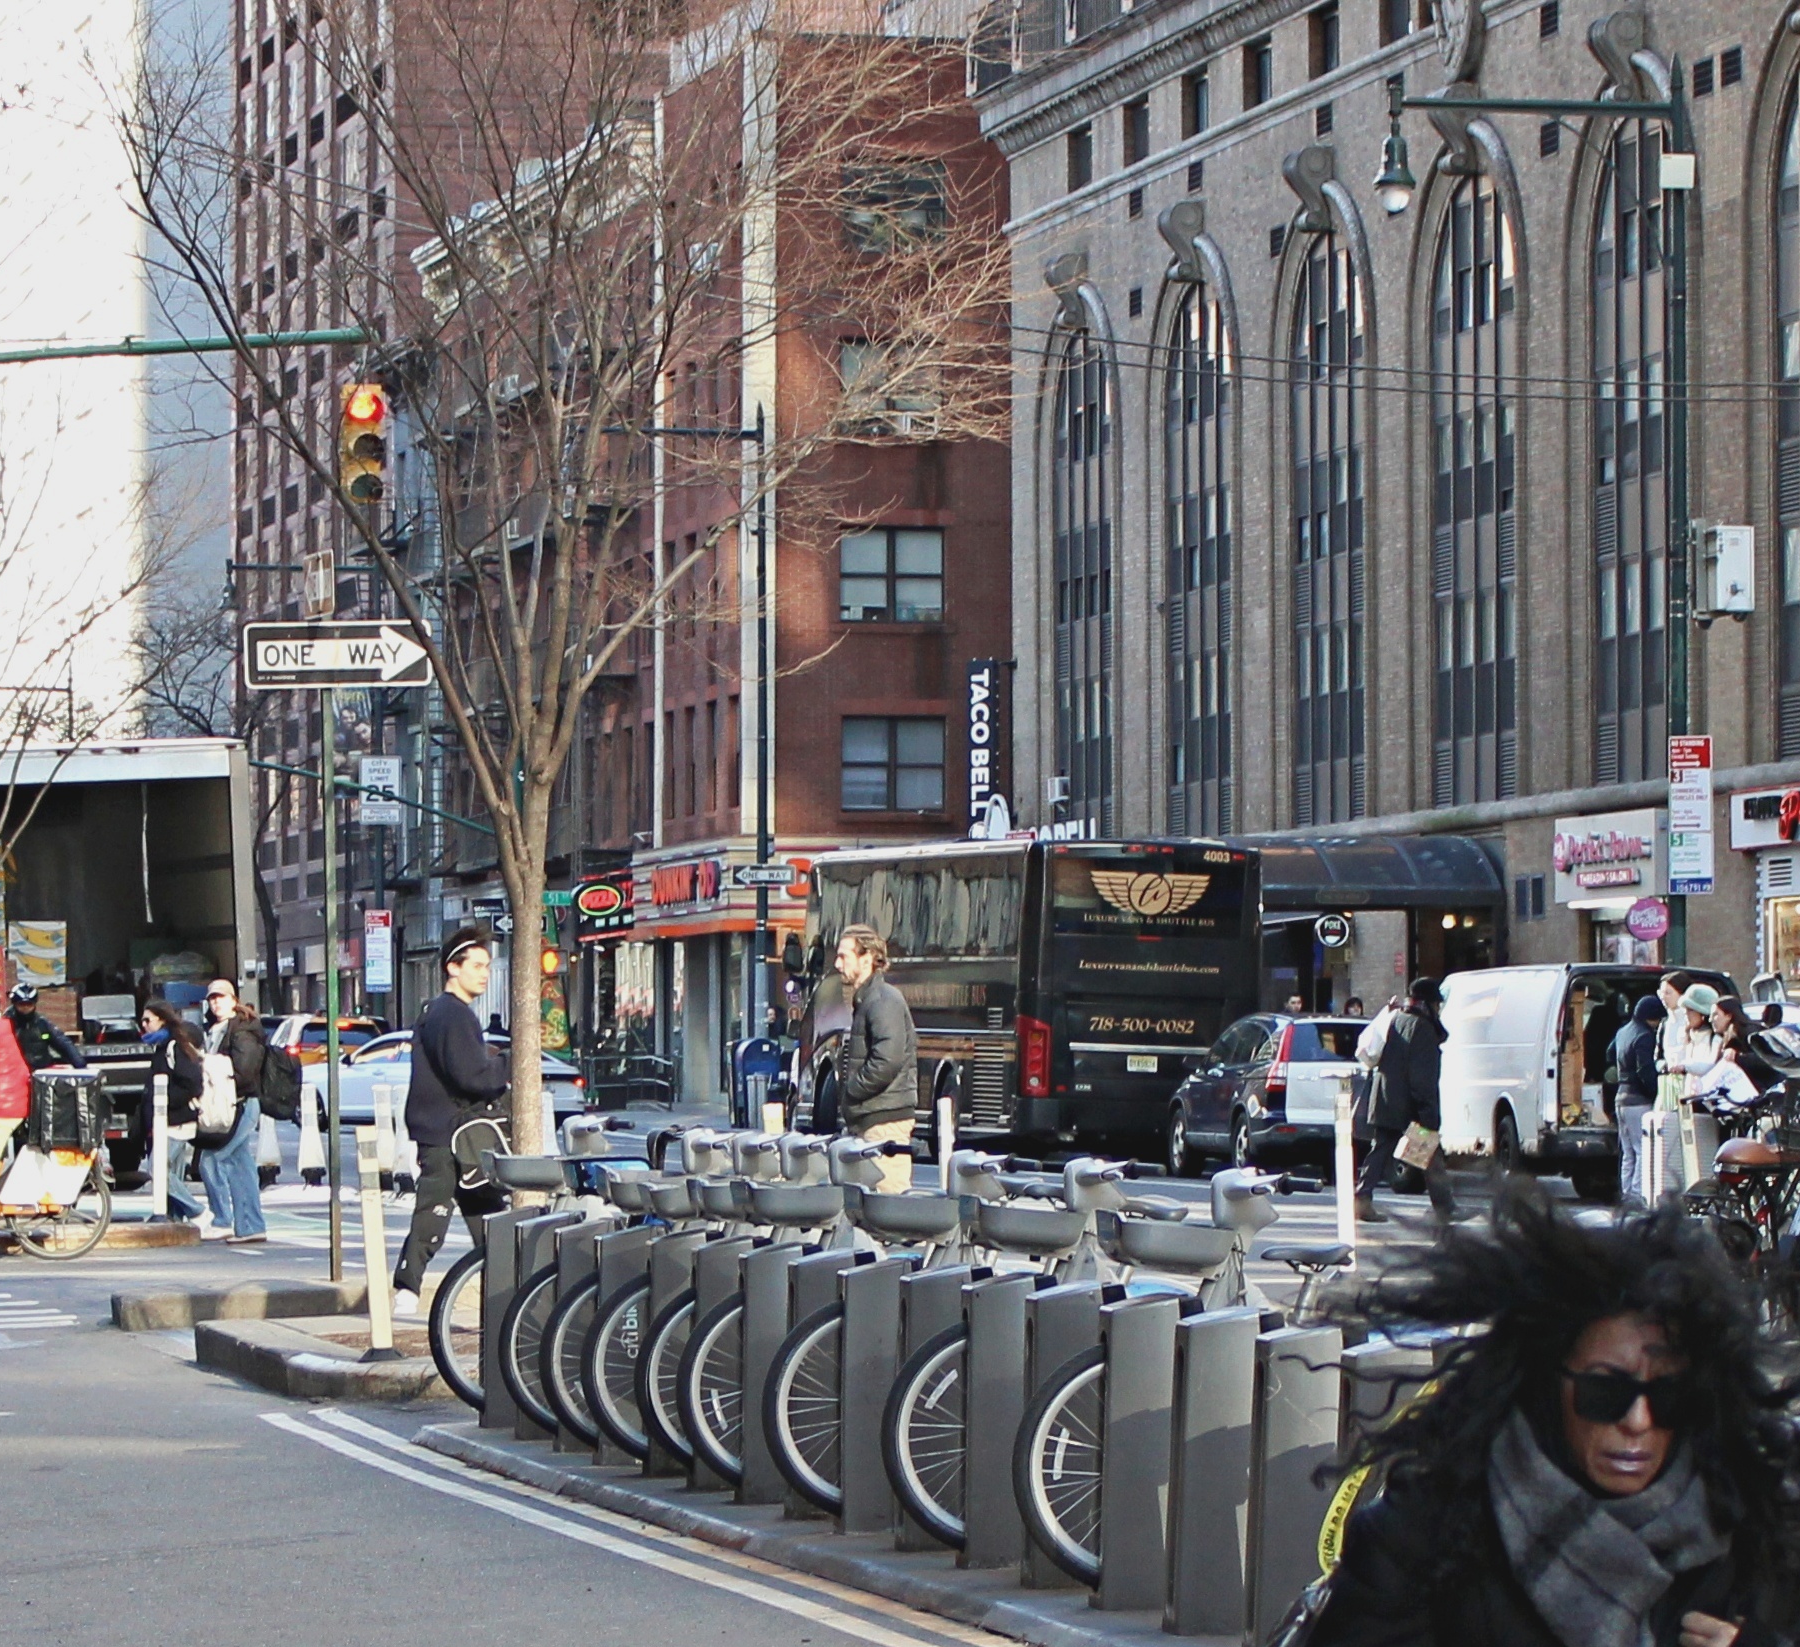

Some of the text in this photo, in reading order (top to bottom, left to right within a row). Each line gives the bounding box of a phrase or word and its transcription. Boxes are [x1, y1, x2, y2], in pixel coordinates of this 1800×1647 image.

[264, 643, 403, 666] ONE WAY
[970, 668, 990, 817] TACO BELL
[366, 785, 395, 802] 25
[1203, 851, 1231, 863] 4003
[742, 871, 788, 879] ONE WAY
[1084, 912, 1117, 923] LUXURY
[1121, 914, 1144, 924] VANS
[1157, 917, 1195, 926] SHUTTLE
[1199, 918, 1215, 927] BUS
[1089, 1017, 1195, 1034] 718-500-0082
